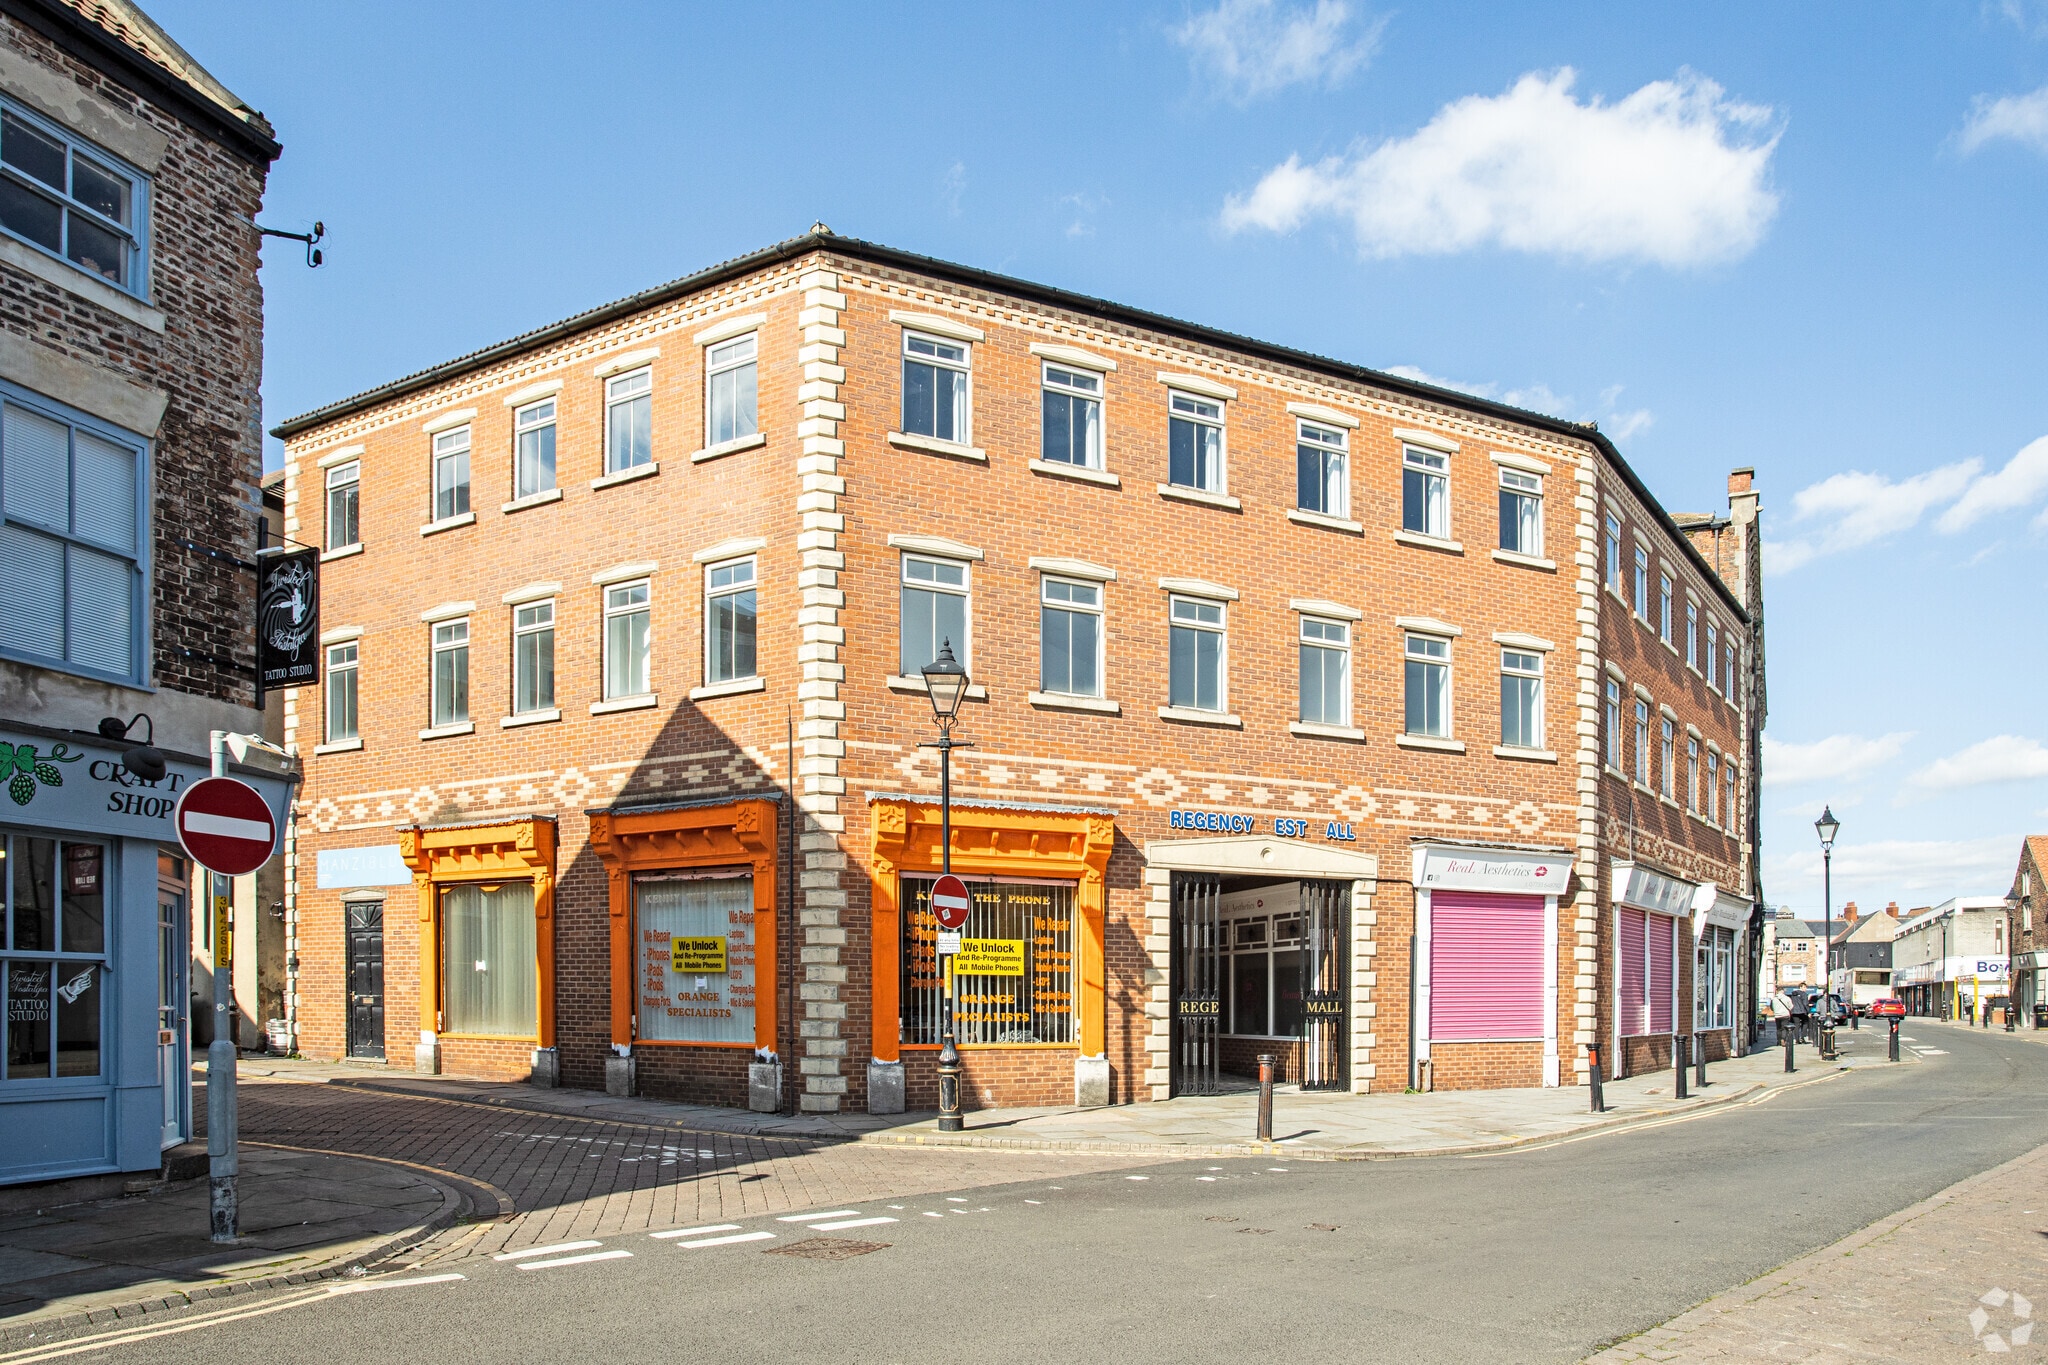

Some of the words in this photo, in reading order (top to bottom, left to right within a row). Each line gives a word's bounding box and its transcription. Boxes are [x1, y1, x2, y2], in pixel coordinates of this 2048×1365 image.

[271, 564, 311, 592] Twisted
[265, 668, 287, 681] TATTOO
[289, 664, 312, 678] STUDIO
[89, 760, 185, 792] CRAT
[107, 791, 175, 819] SHOP
[1170, 811, 1253, 832] REGENCY
[1275, 819, 1307, 836] EST
[1326, 822, 1355, 840] ALL
[1477, 863, 1531, 877] Aesthetics
[974, 893, 1001, 903] THE
[1008, 894, 1050, 905] PHONE
[728, 910, 738, 924] We
[907, 910, 919, 925] We
[1034, 917, 1046, 931] We
[1046, 917, 1071, 933] Repair
[644, 929, 652, 942] We
[678, 941, 690, 951] We
[692, 941, 718, 951] Unlock
[912, 943, 935, 957] iPads
[963, 943, 978, 953] We
[981, 943, 1015, 953] Unlock
[647, 947, 670, 961] iPhones
[674, 952, 684, 960] And
[684, 952, 724, 961] Re-Programme
[971, 954, 1022, 963] Re-Programme
[647, 963, 664, 977] iPads
[913, 959, 936, 973] iPods
[971, 963, 994, 971] Mobile
[995, 964, 1020, 972] Phones
[10, 969, 49, 983] Twisted
[648, 978, 664, 991] iPods
[678, 992, 720, 1002] ORANGE
[960, 993, 1015, 1004] ORANGE
[8, 999, 49, 1010] TATTOO
[1180, 1001, 1219, 1013] REGE
[1307, 1001, 1343, 1013] MALL
[8, 1010, 49, 1021] STUDIO
[667, 1007, 732, 1018] SPECIALISTS
